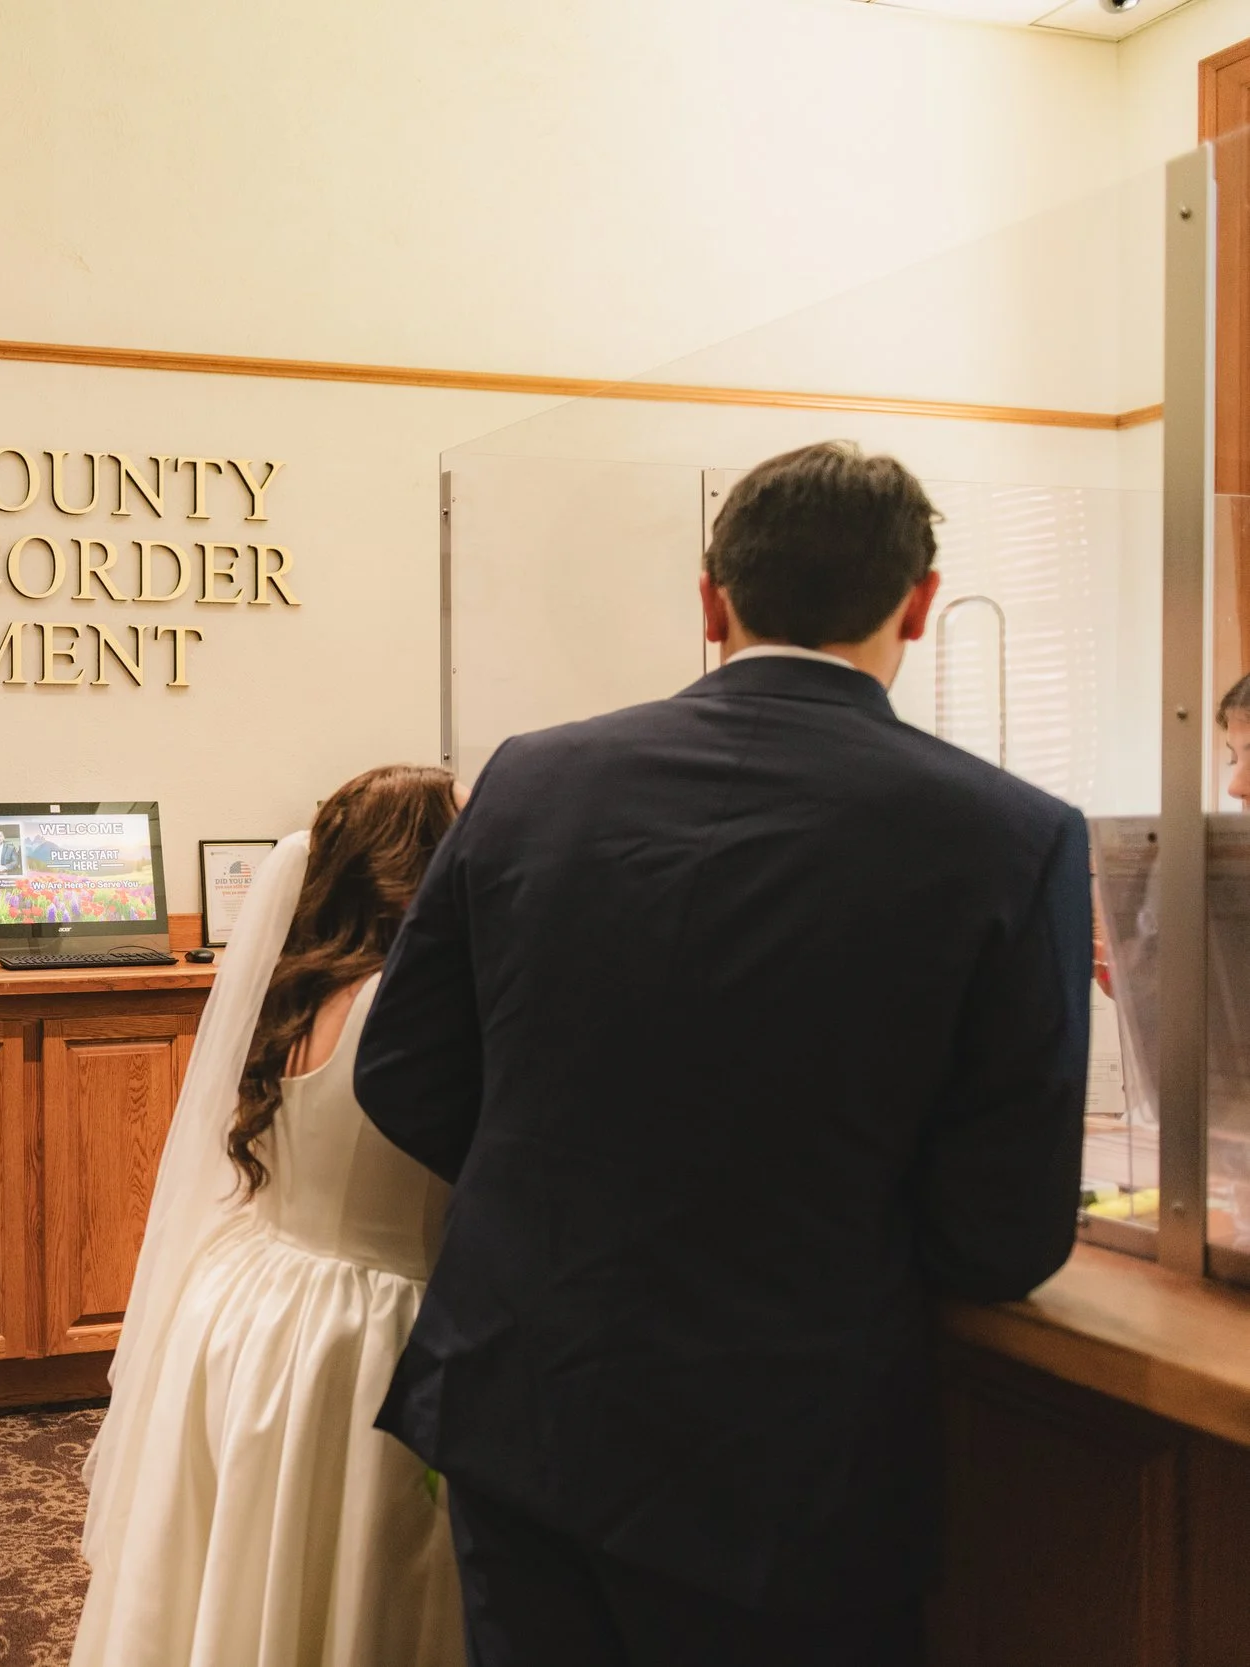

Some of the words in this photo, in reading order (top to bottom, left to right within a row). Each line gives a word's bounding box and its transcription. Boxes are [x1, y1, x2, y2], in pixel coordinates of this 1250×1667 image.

[39, 822, 124, 836] WELCOME
[51, 850, 87, 861] PLEASE
[89, 849, 119, 860] START
[73, 861, 99, 871] HERE
[32, 881, 46, 890] We
[46, 881, 62, 889] Are
[64, 881, 83, 889] Here
[86, 881, 96, 889] To
[97, 880, 122, 888] Serve
[123, 879, 139, 888] You
